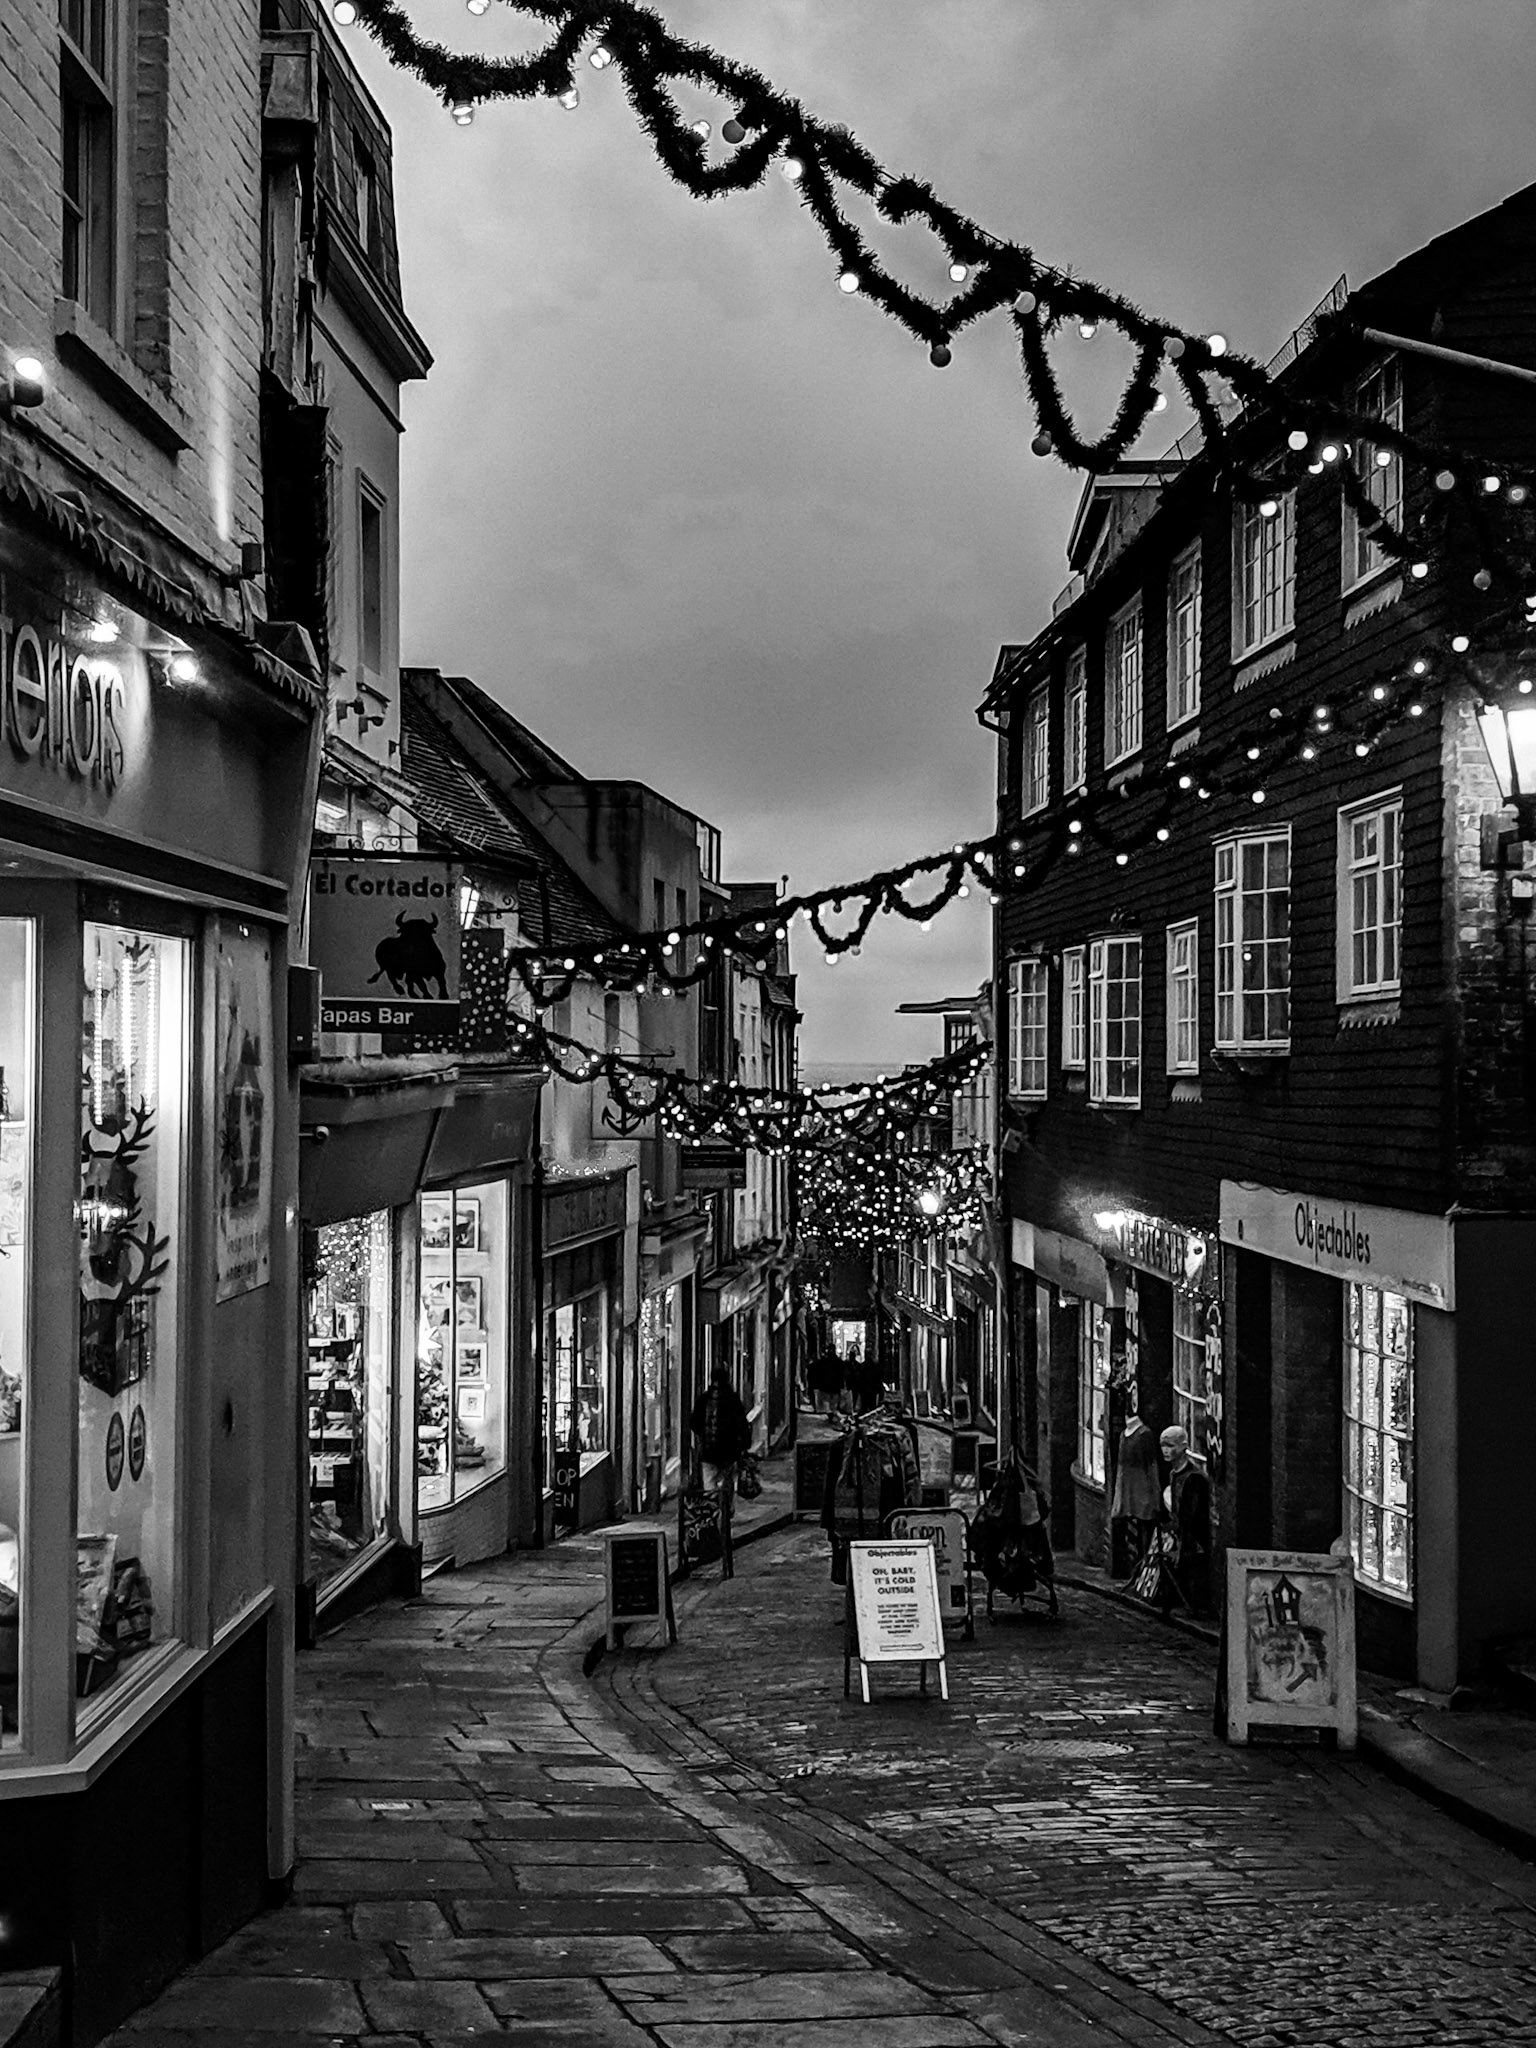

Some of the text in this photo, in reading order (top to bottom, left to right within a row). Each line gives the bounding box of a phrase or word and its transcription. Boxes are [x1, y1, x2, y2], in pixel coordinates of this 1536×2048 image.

[315, 873, 456, 898] El Cortador
[321, 1006, 414, 1026] apas Bar
[1295, 1201, 1371, 1265] Objectables
[877, 1586, 915, 1595] OUTSIDE
[892, 1576, 916, 1585] COLD
